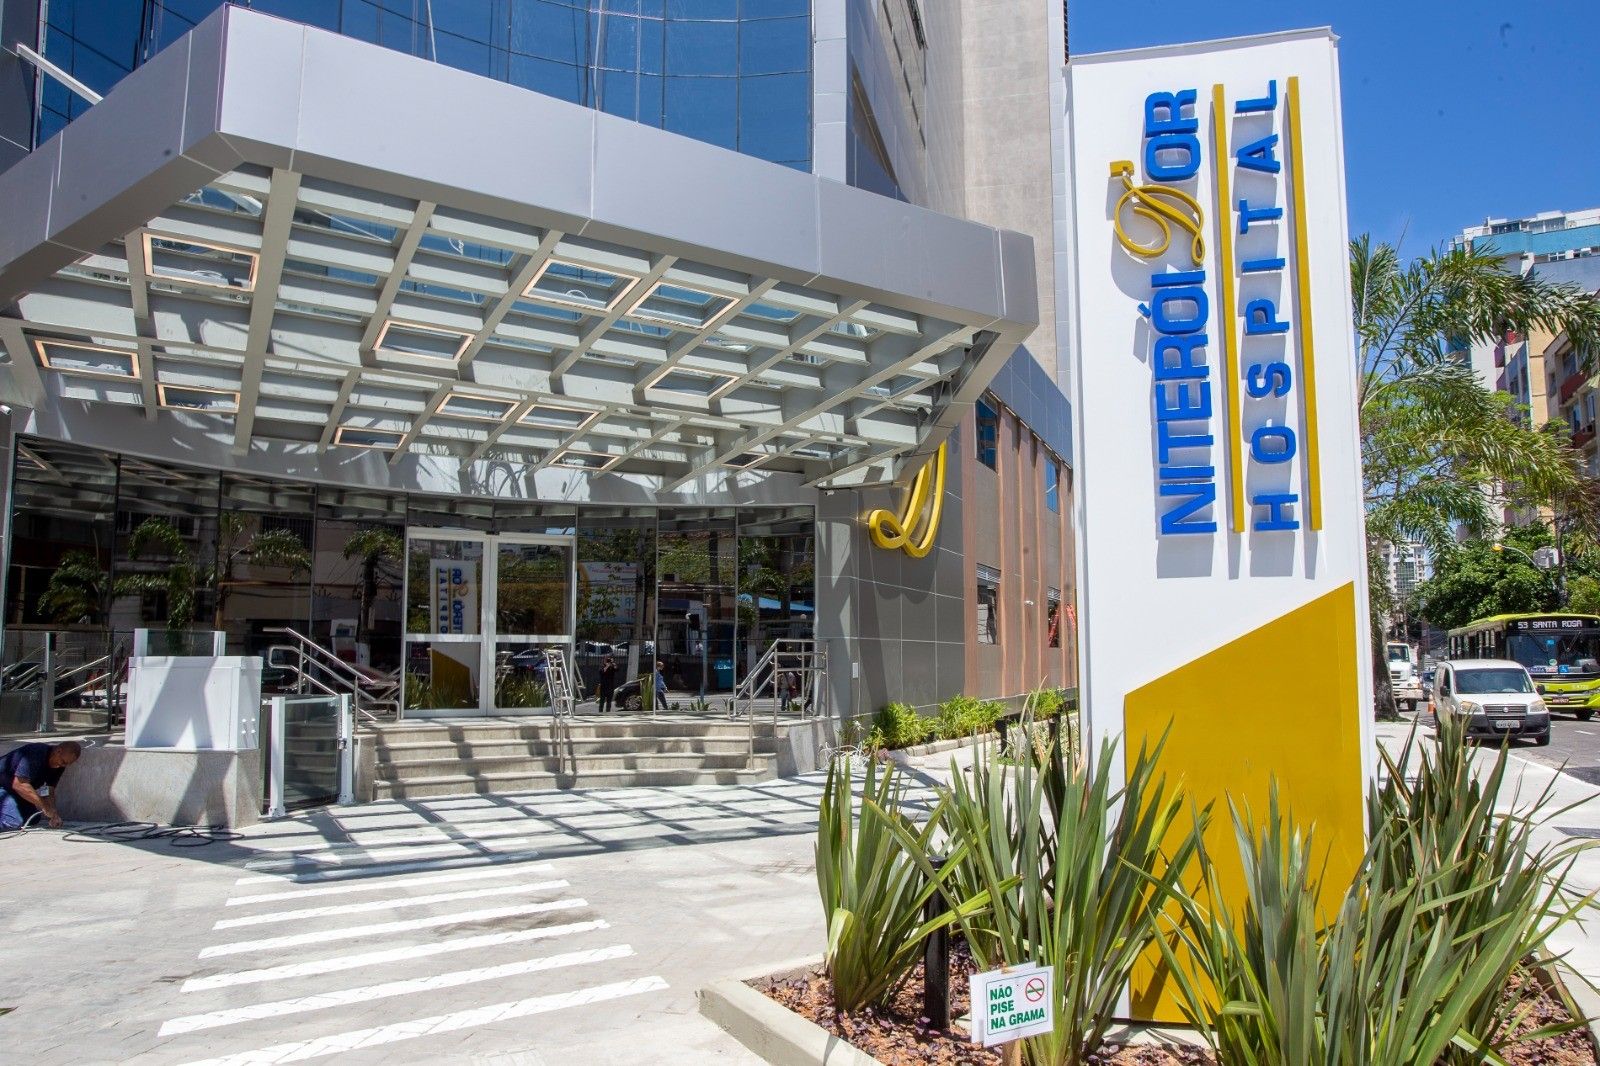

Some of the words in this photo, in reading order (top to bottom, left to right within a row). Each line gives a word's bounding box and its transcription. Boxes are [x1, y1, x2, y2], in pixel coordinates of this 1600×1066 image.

[1235, 79, 1300, 533] HOSPITAL
[1137, 269, 1218, 536] NITERÓI
[1517, 621, 1529, 629] 53
[1532, 620, 1558, 629] SANTA
[1561, 619, 1583, 628] ROSA
[989, 984, 1013, 1000] NÃO
[990, 1000, 1015, 1015] PISE
[990, 1017, 1006, 1030] NA
[1009, 1007, 1045, 1026] GRAMA
